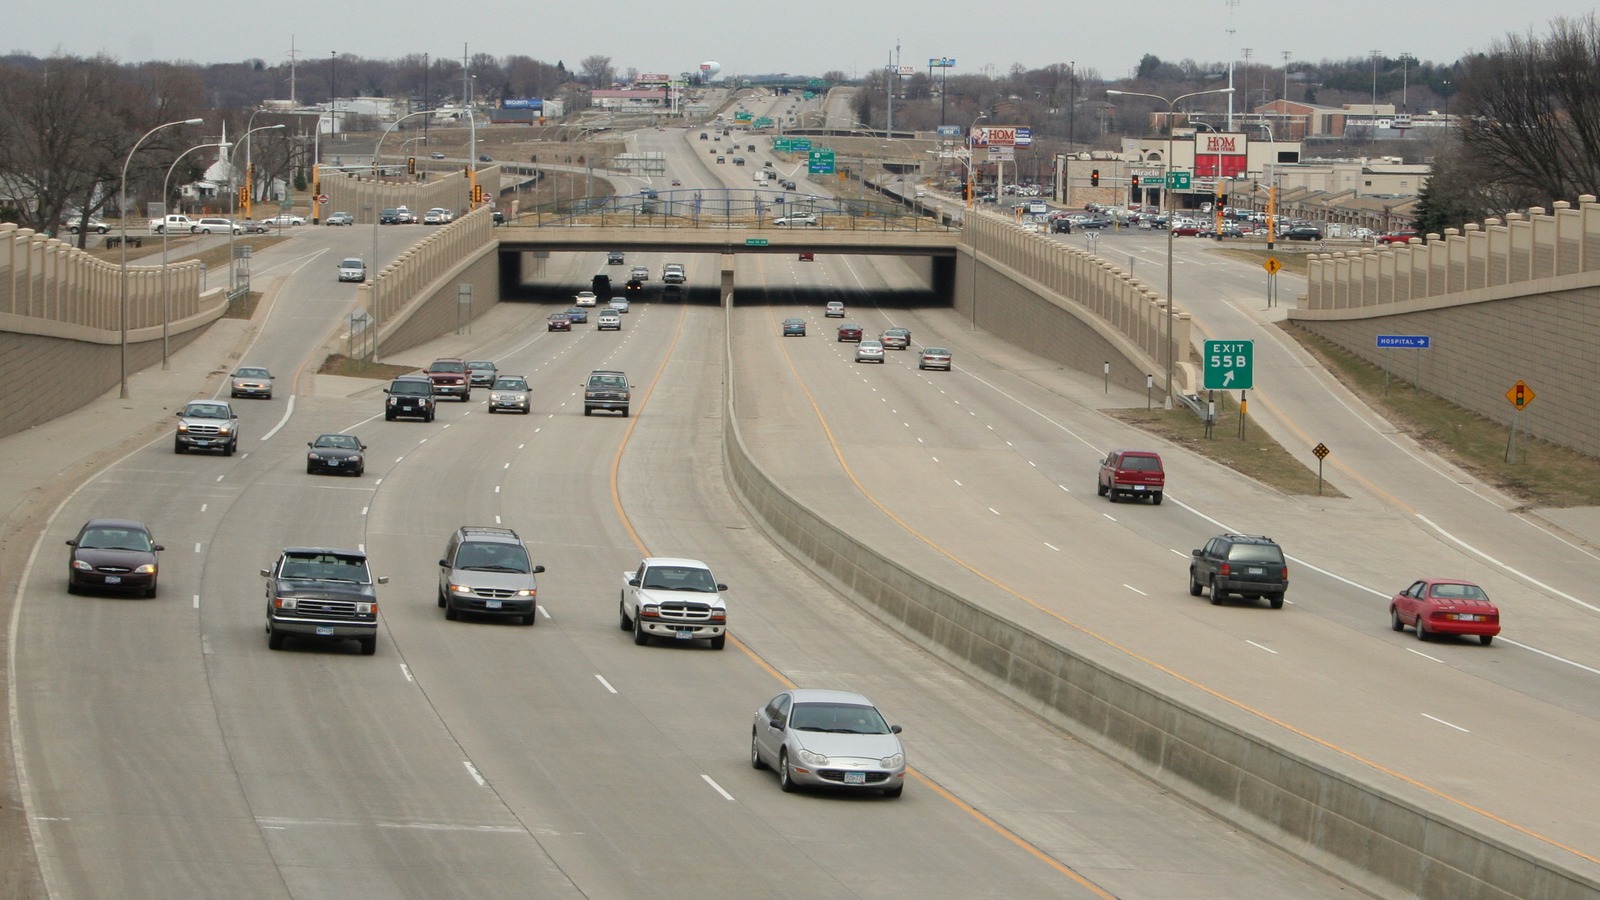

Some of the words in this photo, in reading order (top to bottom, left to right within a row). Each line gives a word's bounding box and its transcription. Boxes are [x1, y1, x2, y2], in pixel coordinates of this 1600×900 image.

[988, 130, 1014, 139] HOM
[1207, 137, 1235, 147] HOM
[1213, 344, 1244, 353] EXIT
[1211, 355, 1246, 368] 55B
